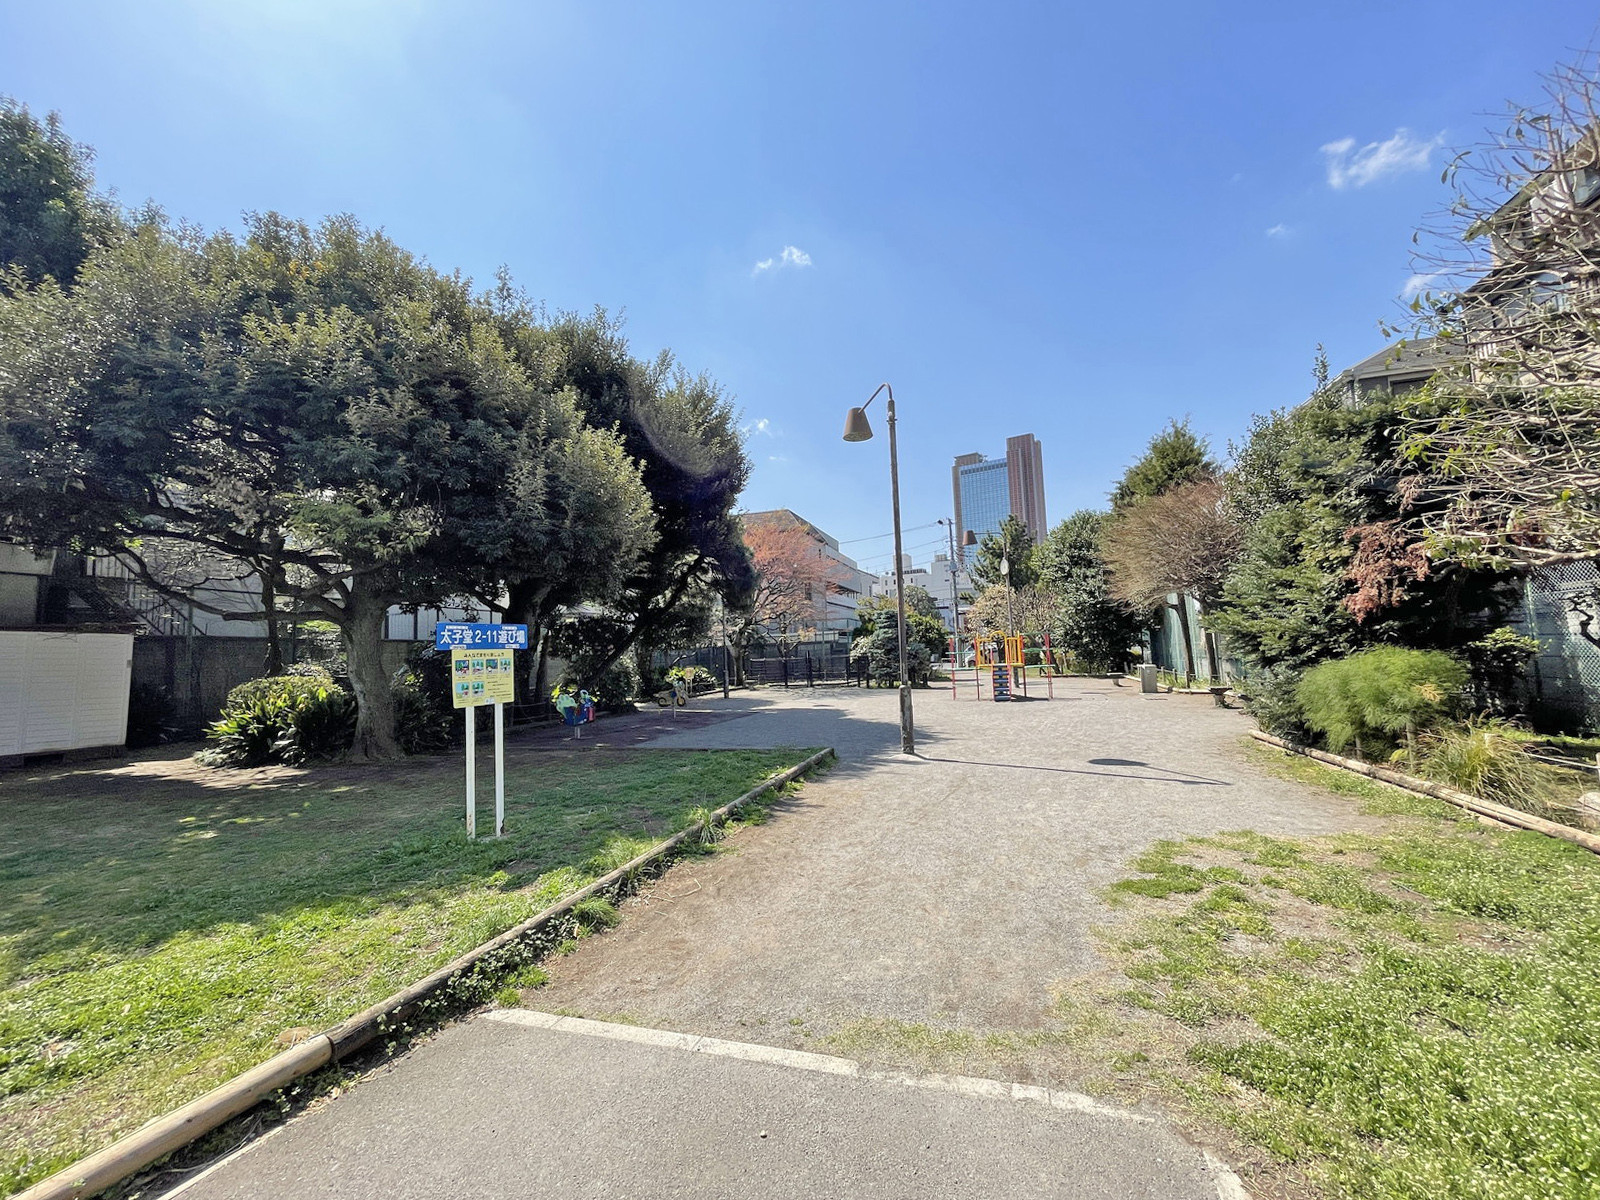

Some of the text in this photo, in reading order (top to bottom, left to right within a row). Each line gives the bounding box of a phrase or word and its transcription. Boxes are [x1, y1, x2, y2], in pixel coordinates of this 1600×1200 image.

[440, 629, 525, 644] 太子堂2-11遊び場
